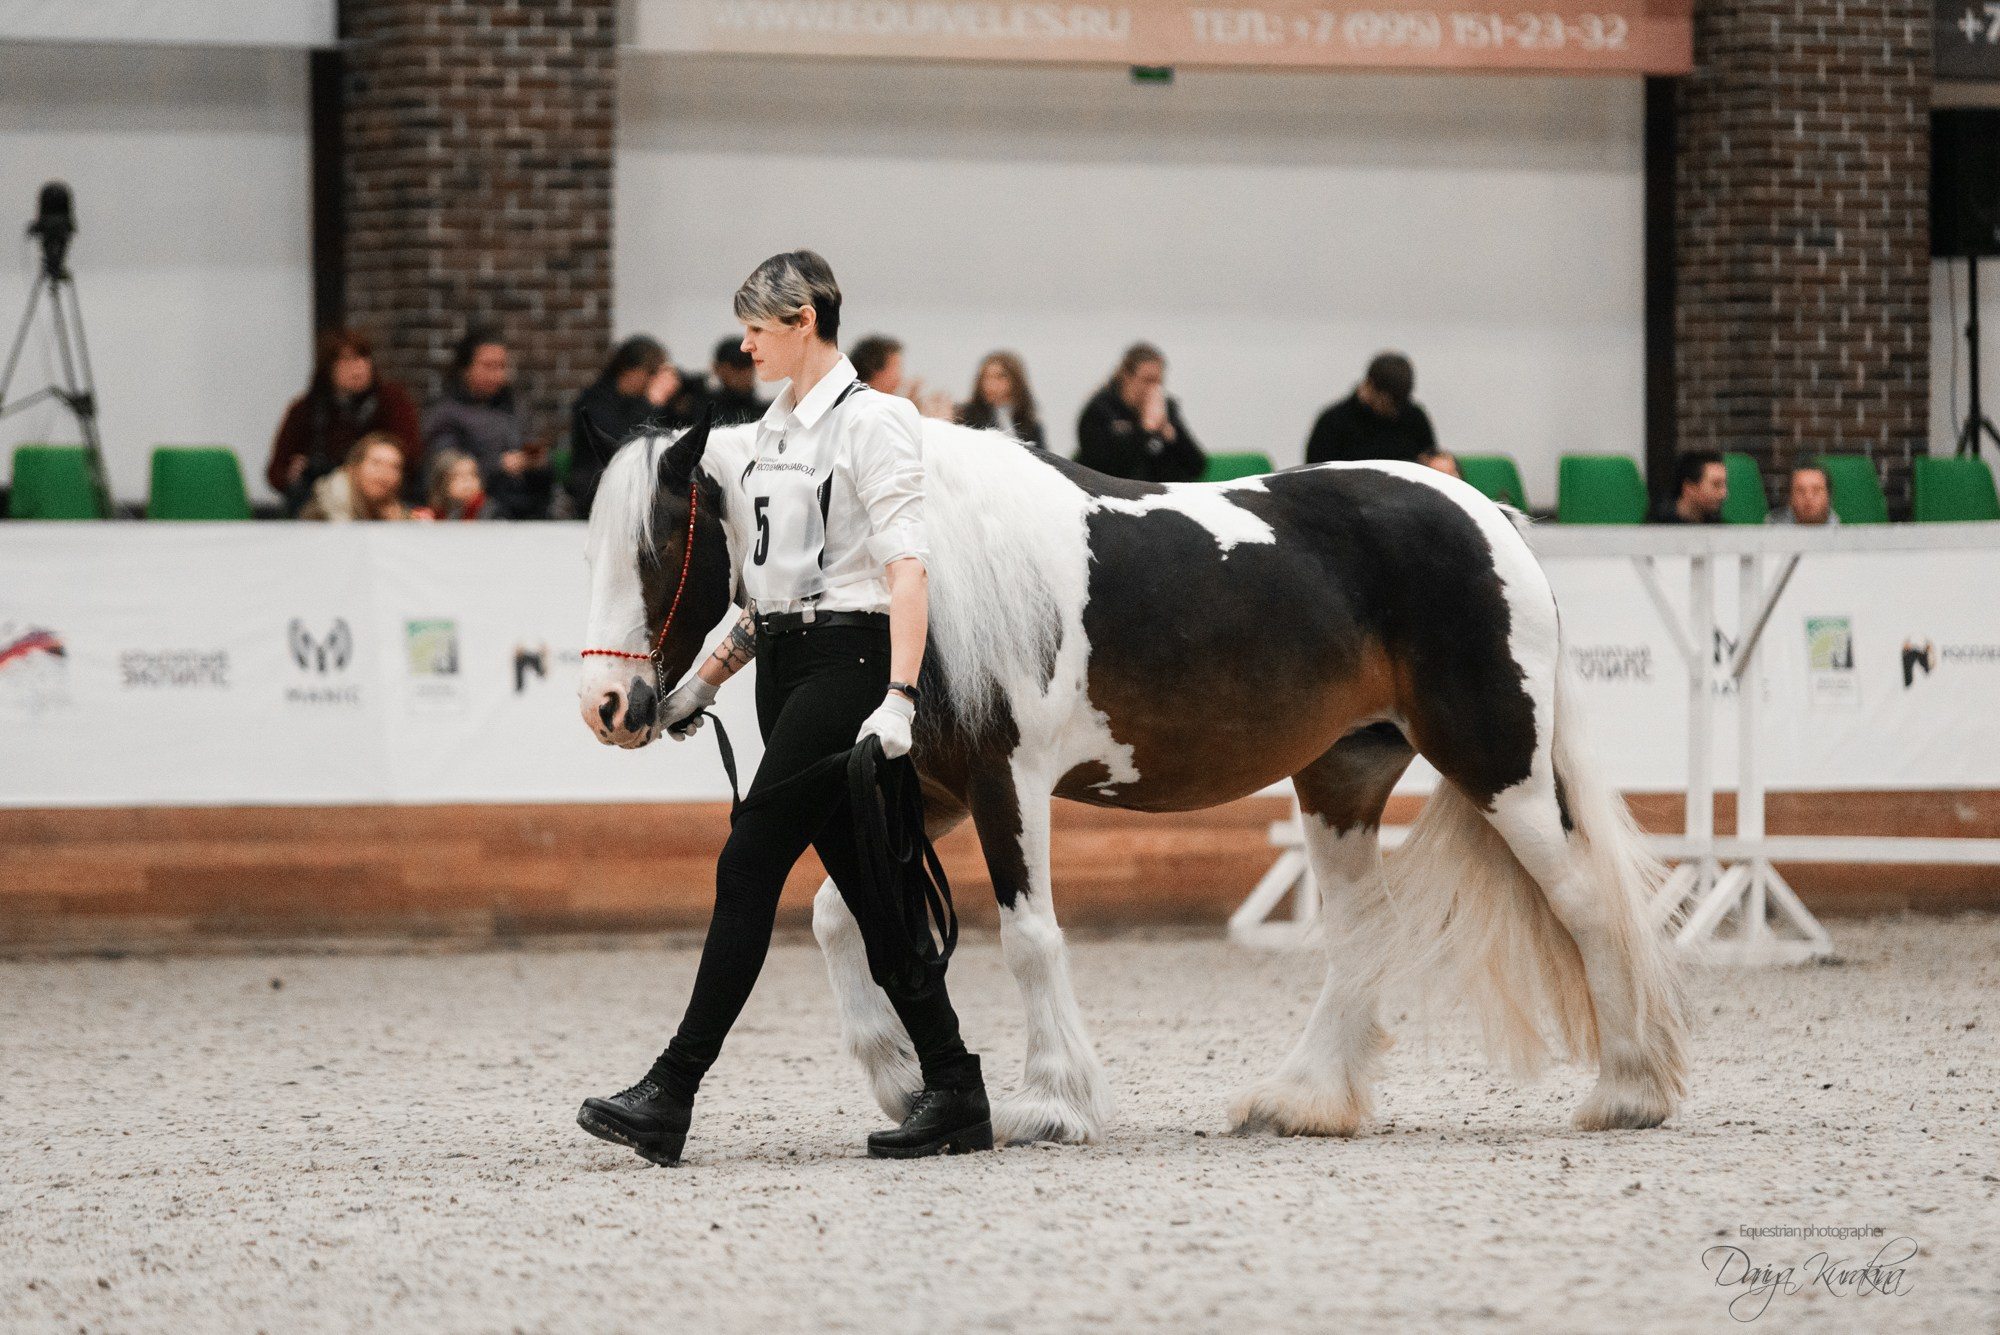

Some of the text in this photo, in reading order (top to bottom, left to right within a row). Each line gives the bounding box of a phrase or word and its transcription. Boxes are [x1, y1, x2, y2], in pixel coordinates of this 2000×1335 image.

[1297, 12, 1334, 44] +7
[1452, 14, 1629, 50] 151-23-32
[1957, 3, 2000, 44] +7
[754, 496, 769, 566] 5
